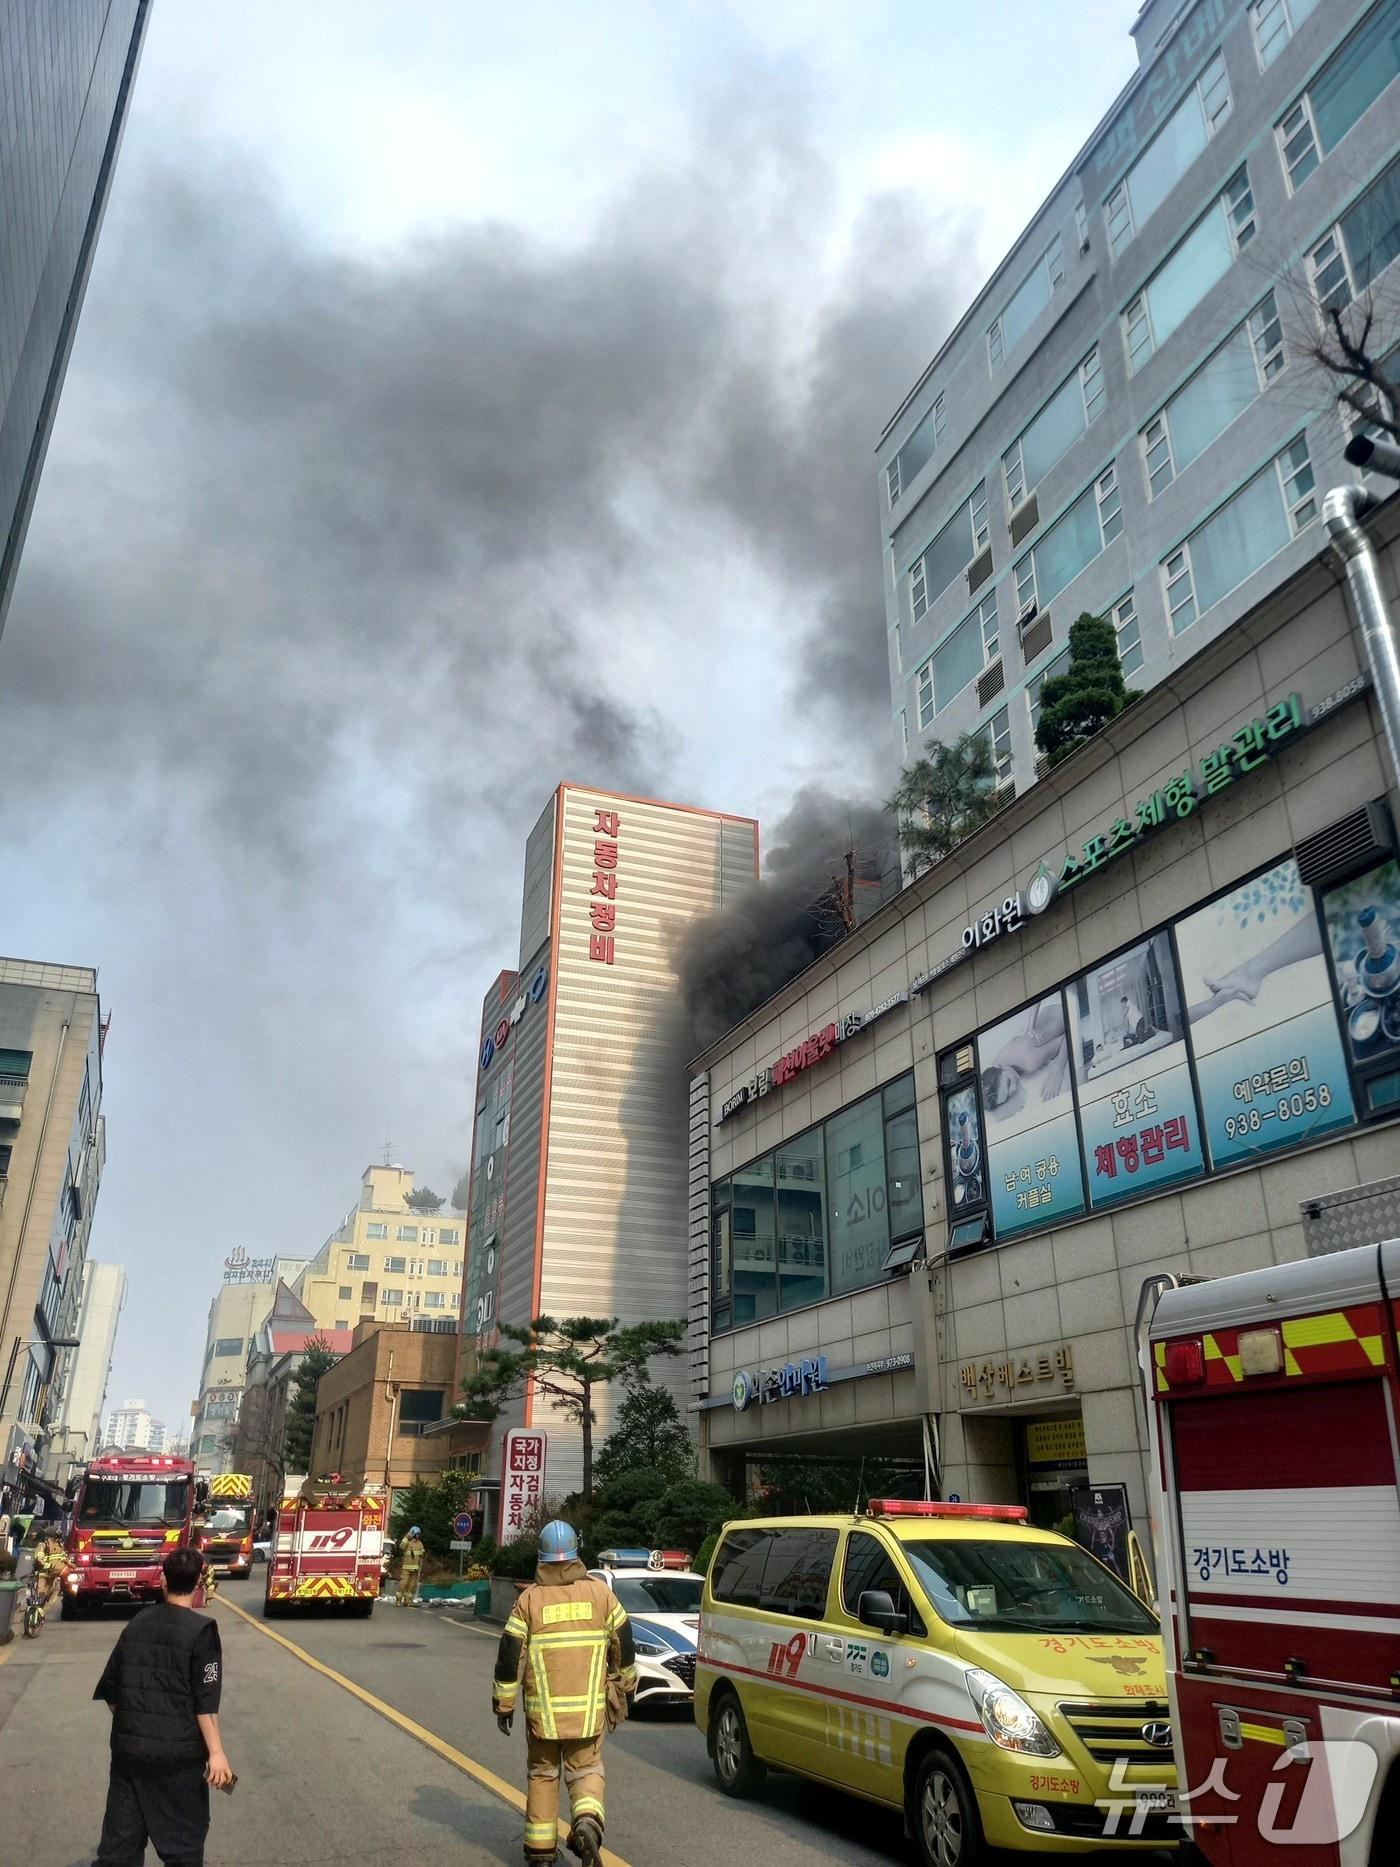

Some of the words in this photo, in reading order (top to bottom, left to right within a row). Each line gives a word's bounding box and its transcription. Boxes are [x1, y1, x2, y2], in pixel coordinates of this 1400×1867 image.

[1200, 693, 1301, 793] 발관리
[590, 809, 620, 965] 자동차정비
[961, 889, 1027, 948] 이화원
[747, 1067, 769, 1104] 보림
[835, 1013, 861, 1041] 매장
[1233, 1055, 1309, 1104] 예약문의
[1112, 1082, 1159, 1127] 효소
[1225, 1083, 1332, 1140] 938-8058
[1035, 1154, 1060, 1181] 공용
[1094, 1115, 1190, 1178] 체형관리
[1015, 1185, 1052, 1211] 커플실
[886, 1354, 911, 1370] 973-0908
[960, 1344, 1075, 1400] 백산베스트빌
[514, 1455, 538, 1470] 지정
[515, 1439, 539, 1454] 국가
[508, 1474, 525, 1530] 자동차
[308, 1528, 353, 1550] 119
[1193, 1547, 1290, 1585] 경기도소방
[767, 1632, 806, 1678] 119
[1039, 1637, 1160, 1654] 경기도소방
[1030, 1775, 1079, 1794] 경기도소방
